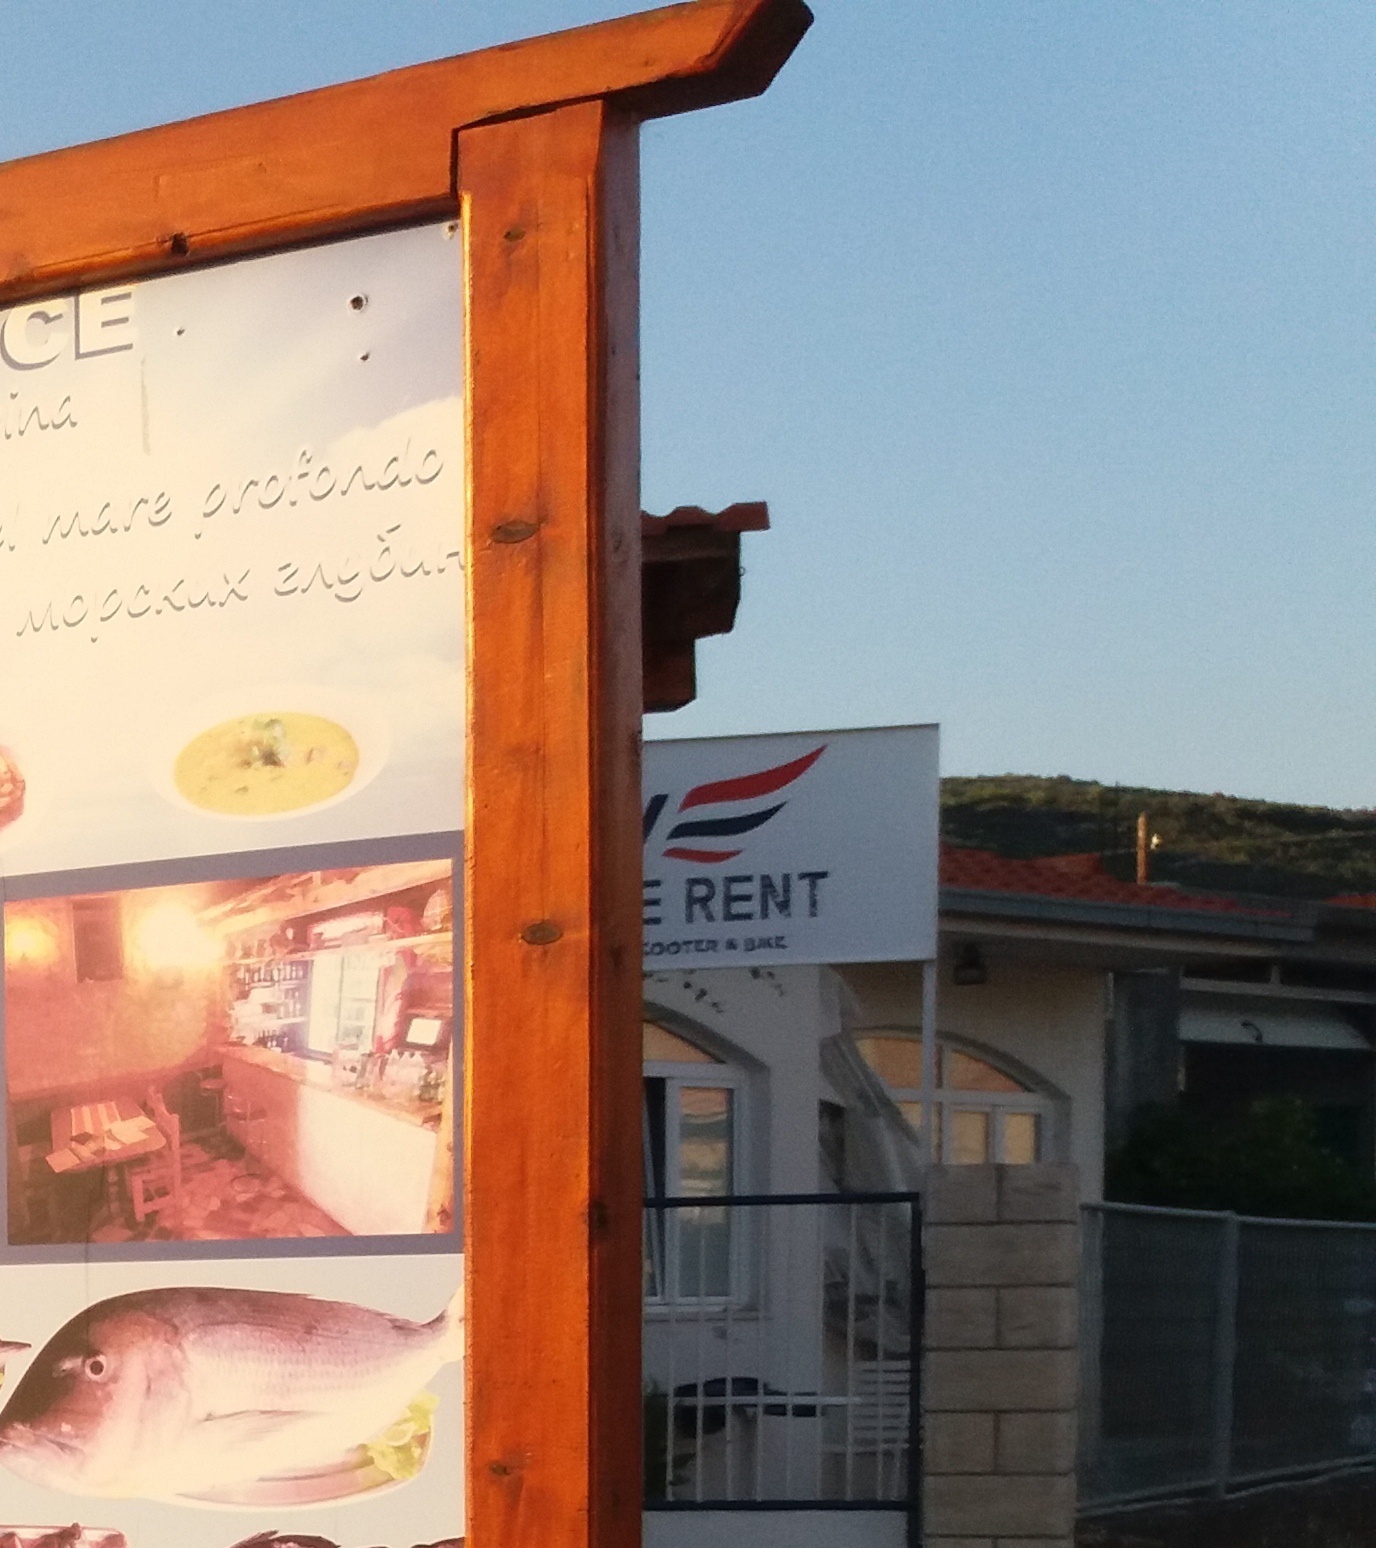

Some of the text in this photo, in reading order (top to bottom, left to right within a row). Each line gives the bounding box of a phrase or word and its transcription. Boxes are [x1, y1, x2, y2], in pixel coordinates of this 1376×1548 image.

[41, 493, 174, 547] mare
[197, 436, 445, 541] profondo
[685, 870, 830, 924] RENT
